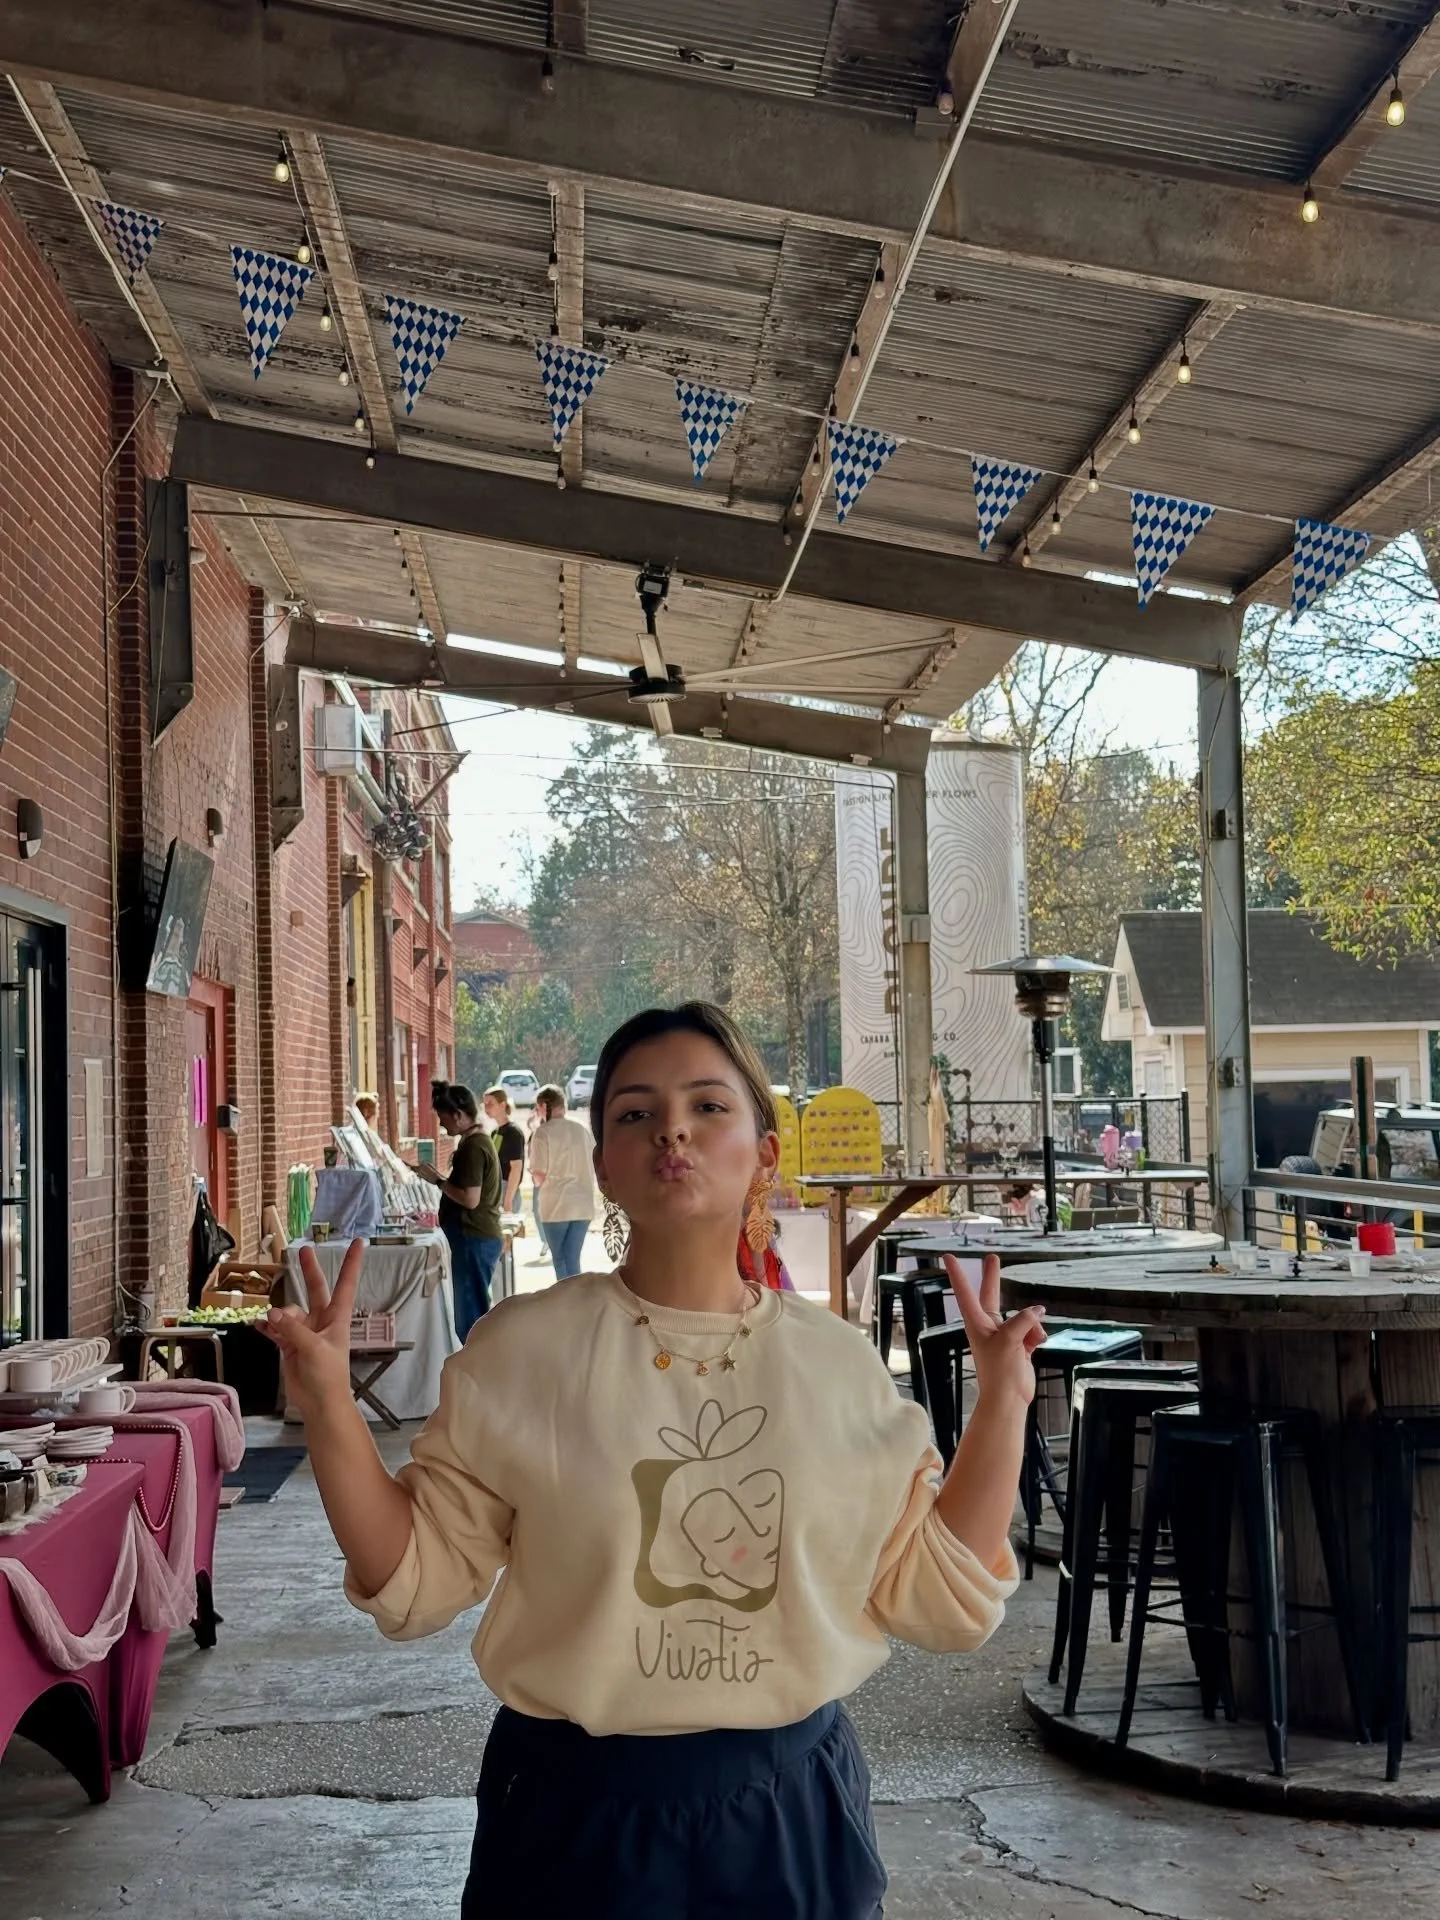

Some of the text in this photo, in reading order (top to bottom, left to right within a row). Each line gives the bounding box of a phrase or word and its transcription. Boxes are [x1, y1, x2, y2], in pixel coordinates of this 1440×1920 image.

[943, 790, 977, 799] FLOWS
[944, 1031, 959, 1041] CO.
[635, 1616, 774, 1683] Vivatia
